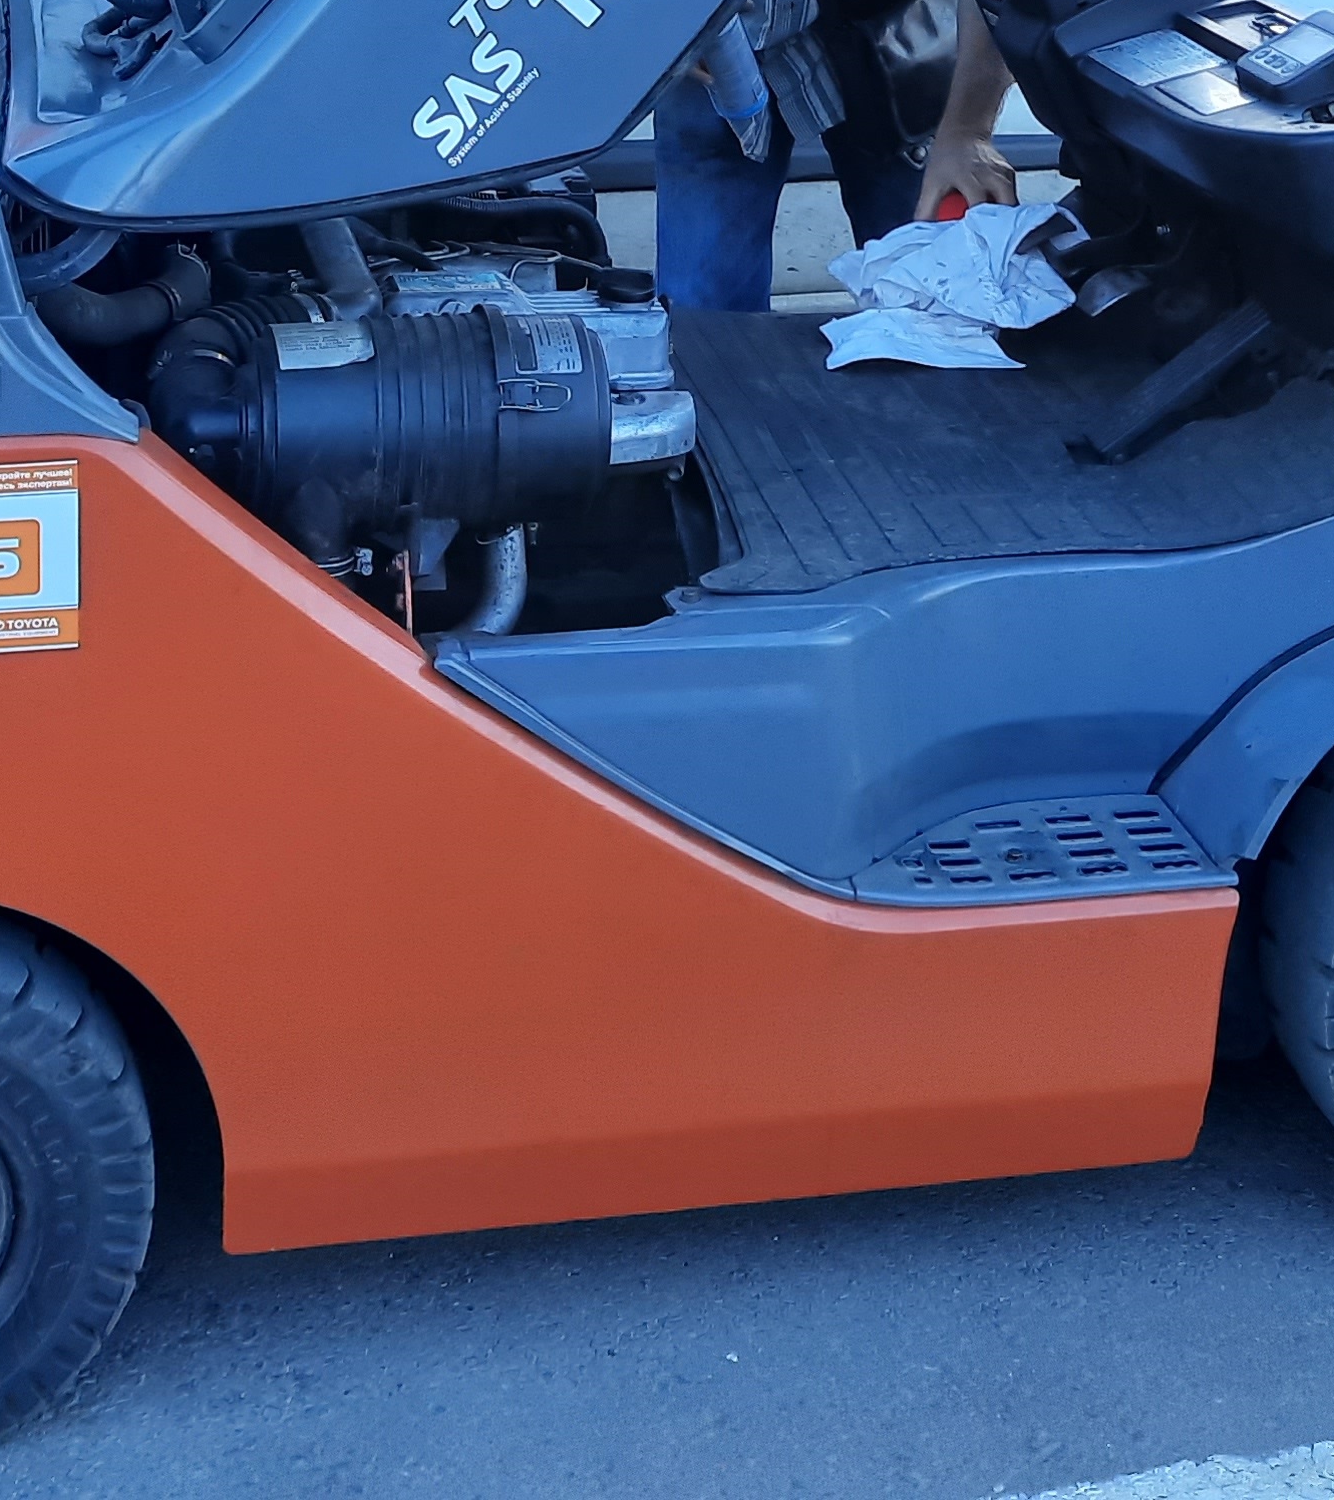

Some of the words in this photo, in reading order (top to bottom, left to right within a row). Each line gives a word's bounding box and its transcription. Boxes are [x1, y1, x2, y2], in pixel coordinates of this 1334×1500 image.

[411, 32, 524, 160] SAS
[447, 135, 479, 168] System
[476, 123, 487, 138] of
[484, 101, 510, 129] Active
[6, 616, 59, 630] TOYOTA
